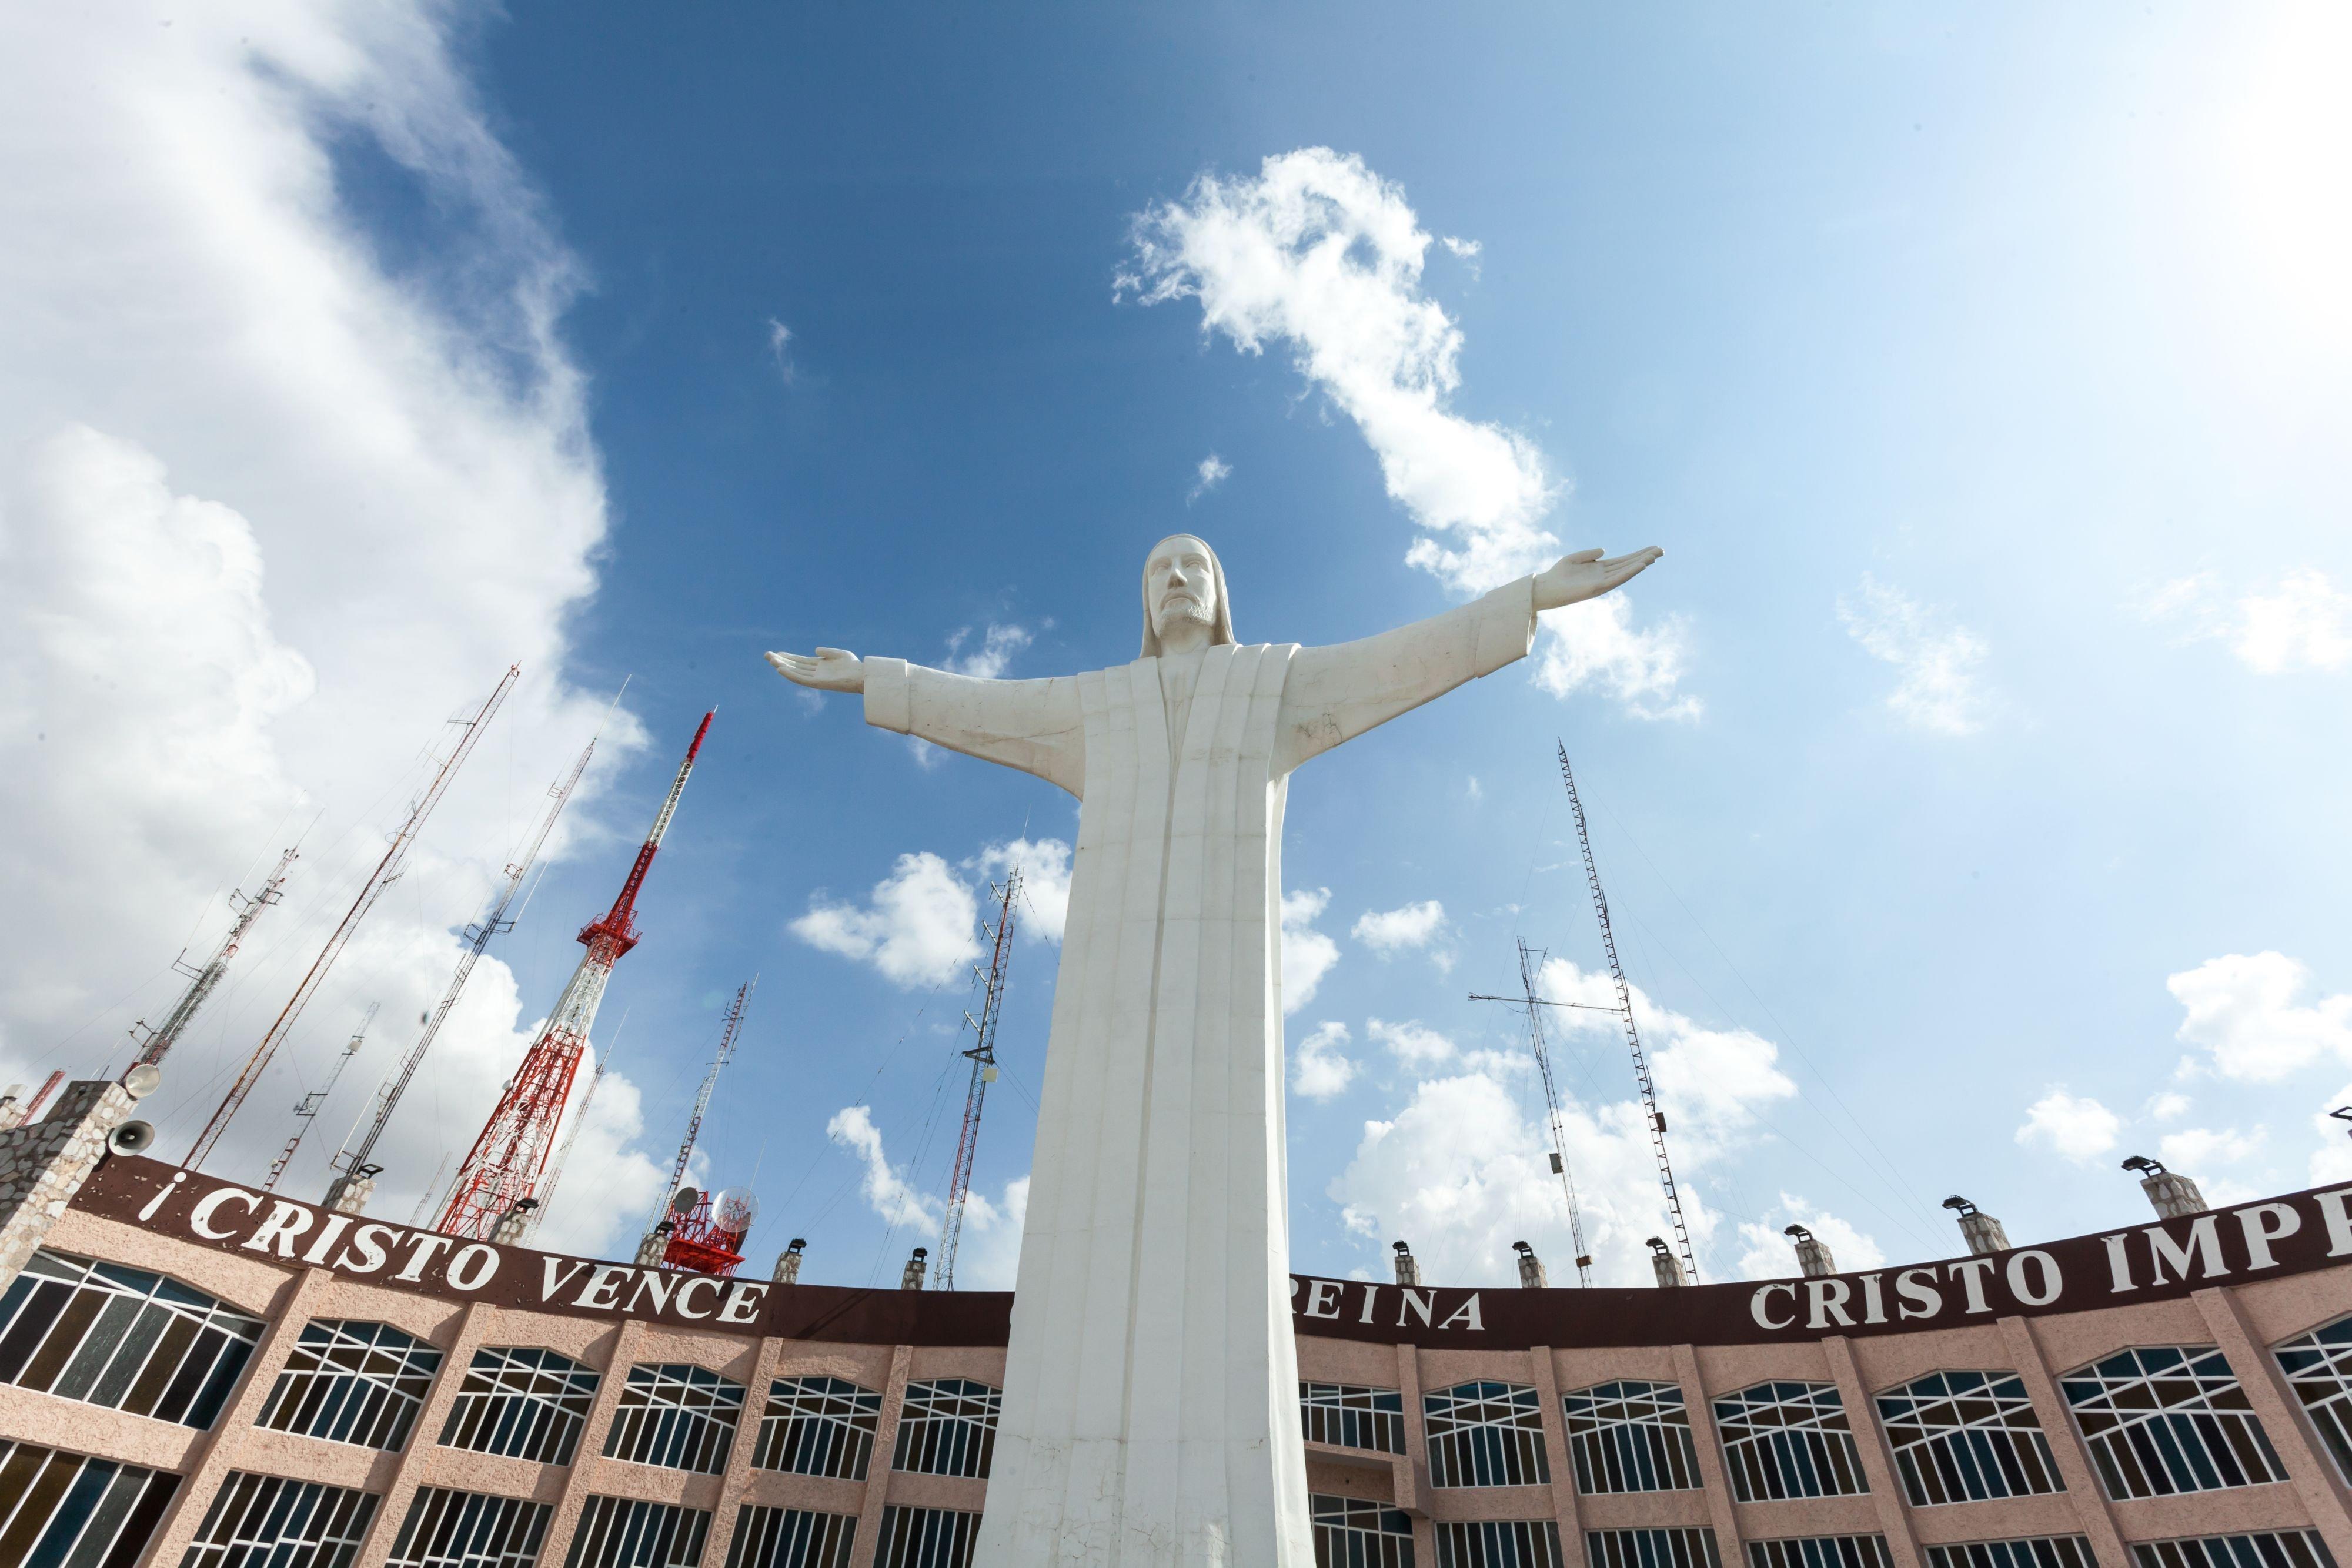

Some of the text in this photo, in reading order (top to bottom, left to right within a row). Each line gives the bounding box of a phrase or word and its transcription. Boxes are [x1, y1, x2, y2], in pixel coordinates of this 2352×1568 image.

[542, 1256, 770, 1324] VENCE
[1289, 1278, 1485, 1330] EINA
[1750, 1250, 2063, 1330] CRISTO
